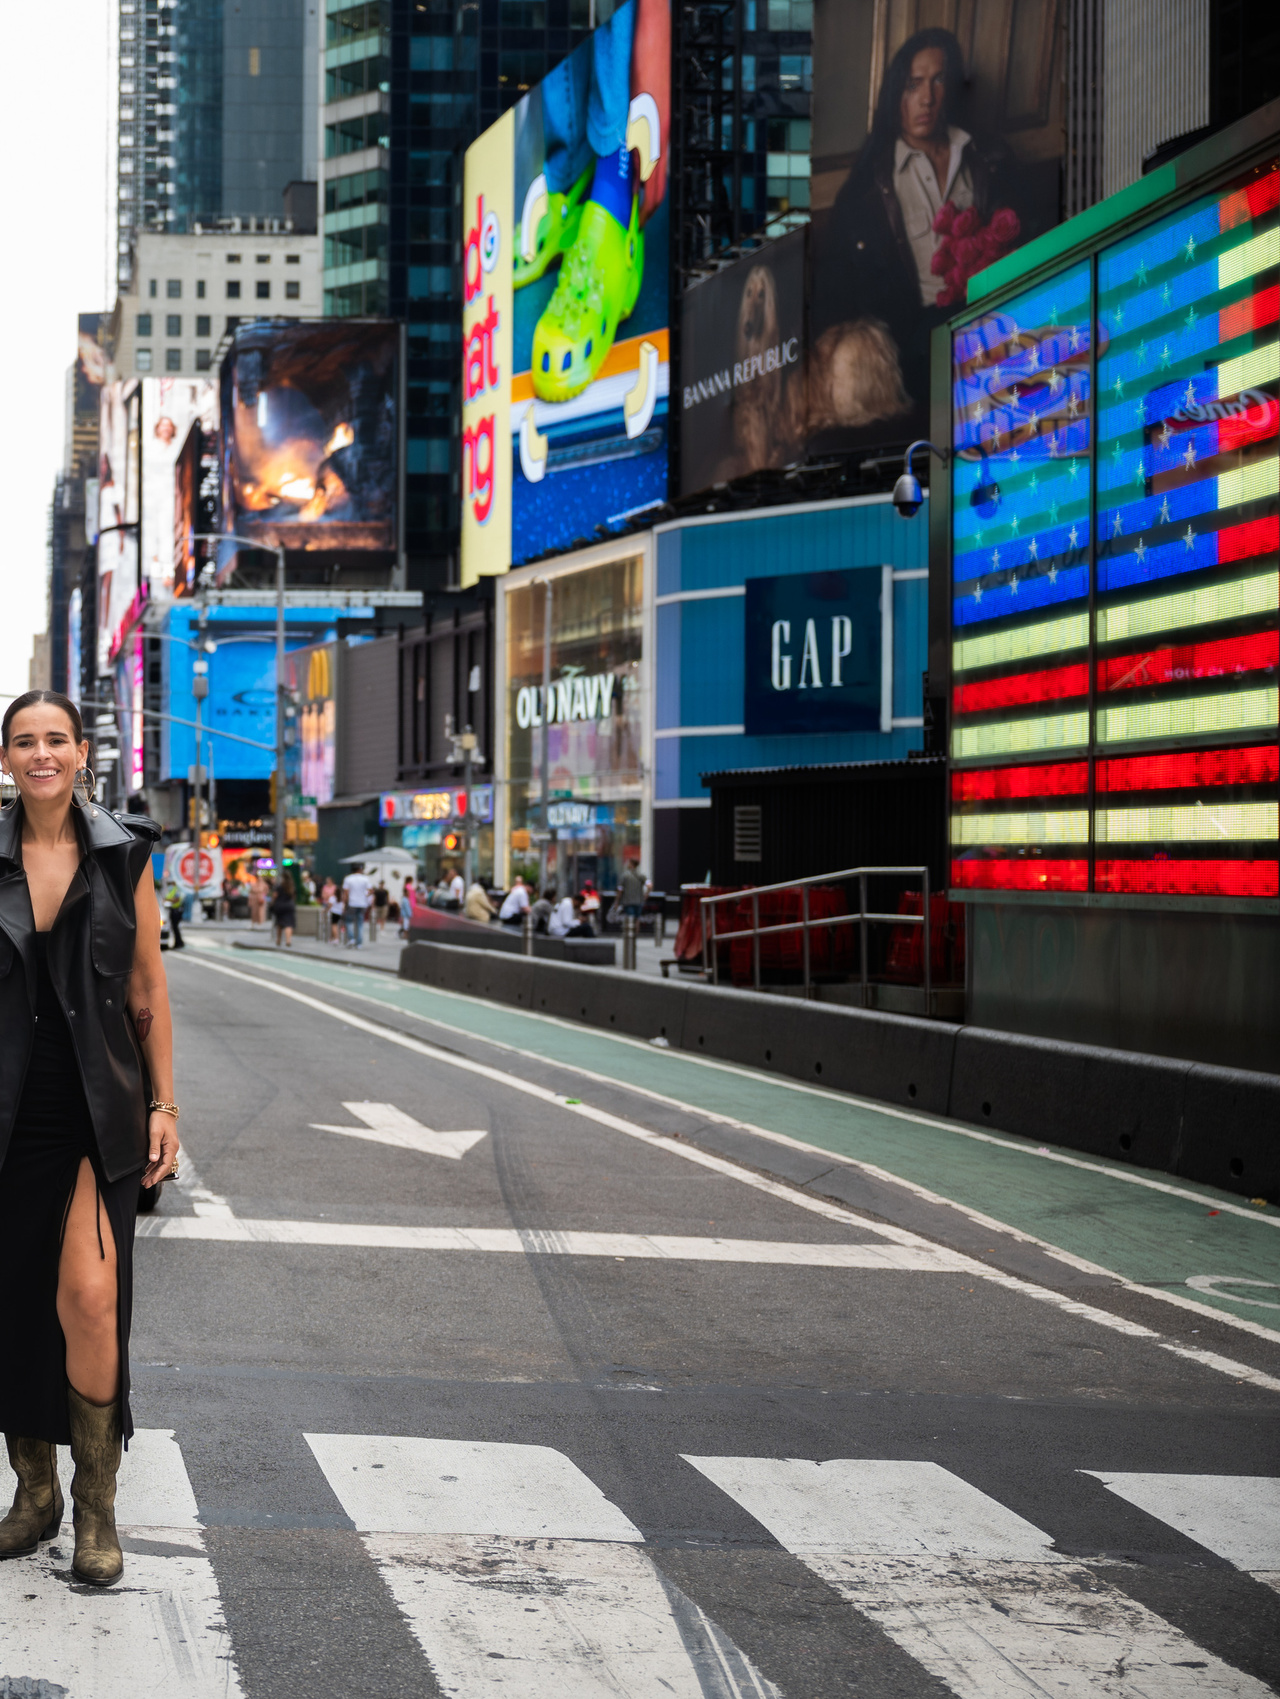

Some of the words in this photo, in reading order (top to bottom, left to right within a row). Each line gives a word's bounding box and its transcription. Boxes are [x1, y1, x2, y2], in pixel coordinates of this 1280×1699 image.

[682, 369, 731, 410] BANANA
[733, 336, 799, 387] REPUBLIC
[771, 615, 852, 692] GAP
[516, 686, 556, 729] OLD
[556, 672, 615, 724] NAVY
